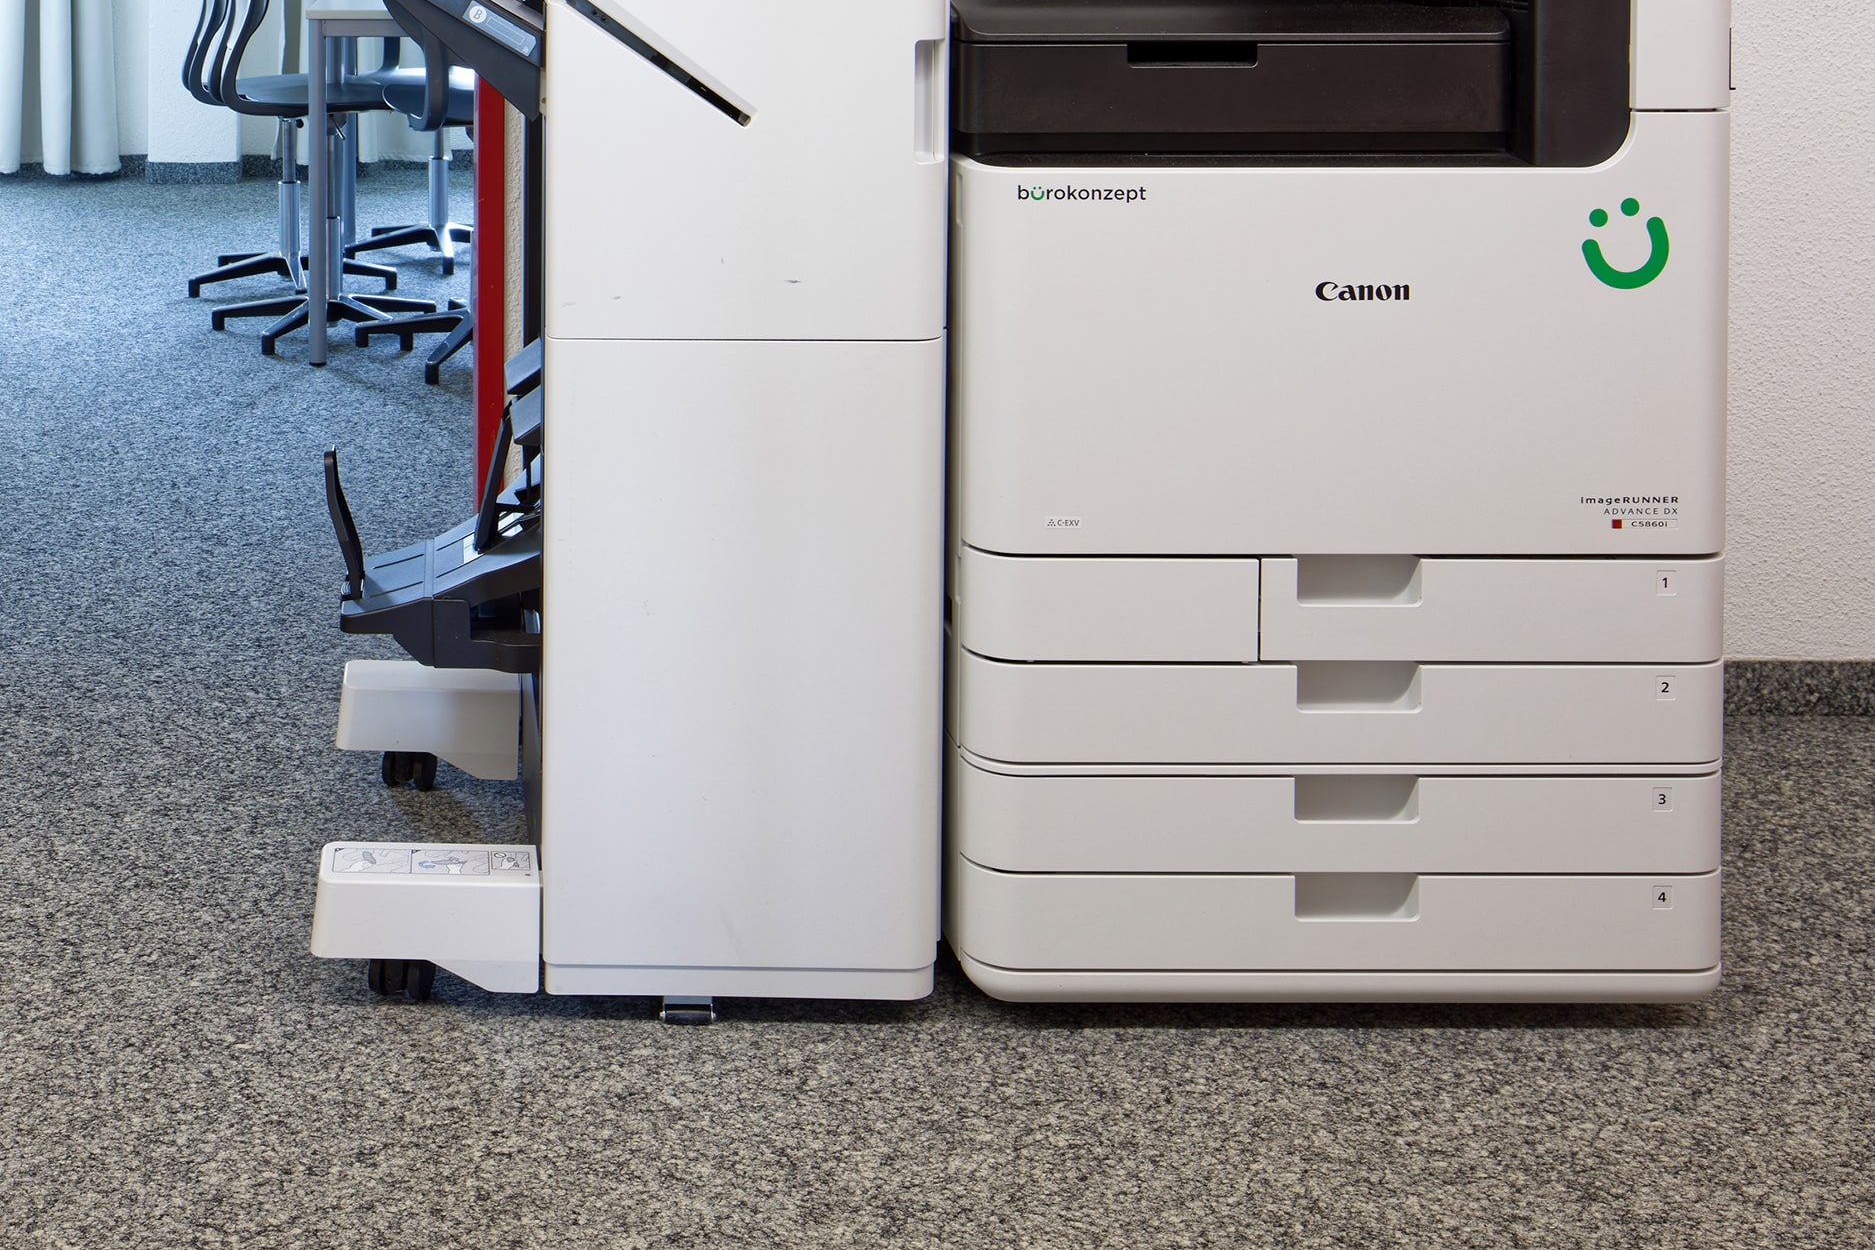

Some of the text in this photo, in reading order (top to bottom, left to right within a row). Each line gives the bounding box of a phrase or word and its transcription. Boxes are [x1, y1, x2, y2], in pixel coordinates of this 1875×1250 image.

[473, 9, 483, 20] B
[1017, 184, 1147, 203] bürokonzept
[1315, 281, 1410, 301] Canon
[1580, 496, 1679, 506] imageRUNNER
[1663, 507, 1678, 515] DX
[1631, 520, 1668, 528] C5860i
[1662, 577, 1668, 588] 1
[1661, 681, 1669, 693] 2
[1658, 793, 1667, 805] 3
[1657, 891, 1667, 902] 4
